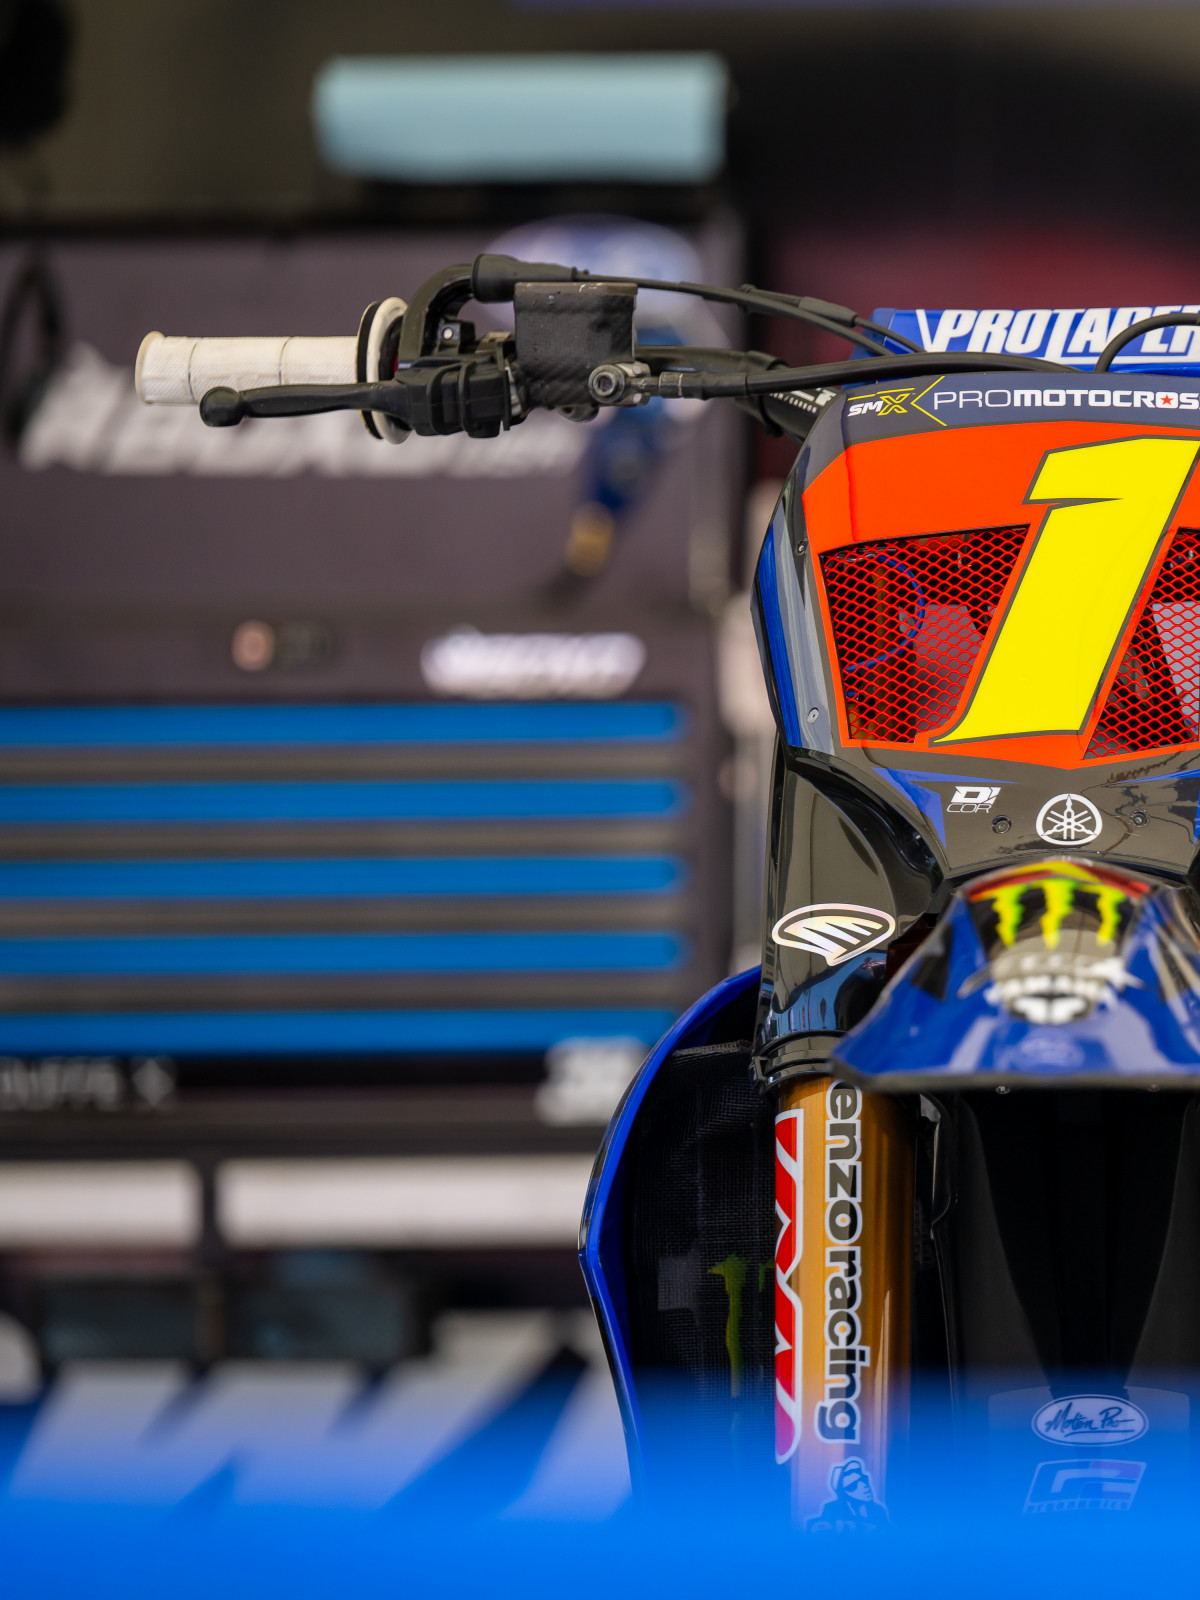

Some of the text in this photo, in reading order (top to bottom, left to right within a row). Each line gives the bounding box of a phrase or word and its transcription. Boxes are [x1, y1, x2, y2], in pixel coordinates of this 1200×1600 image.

[847, 392, 911, 417] SMX
[1045, 1401, 1136, 1435] Motion Pro
